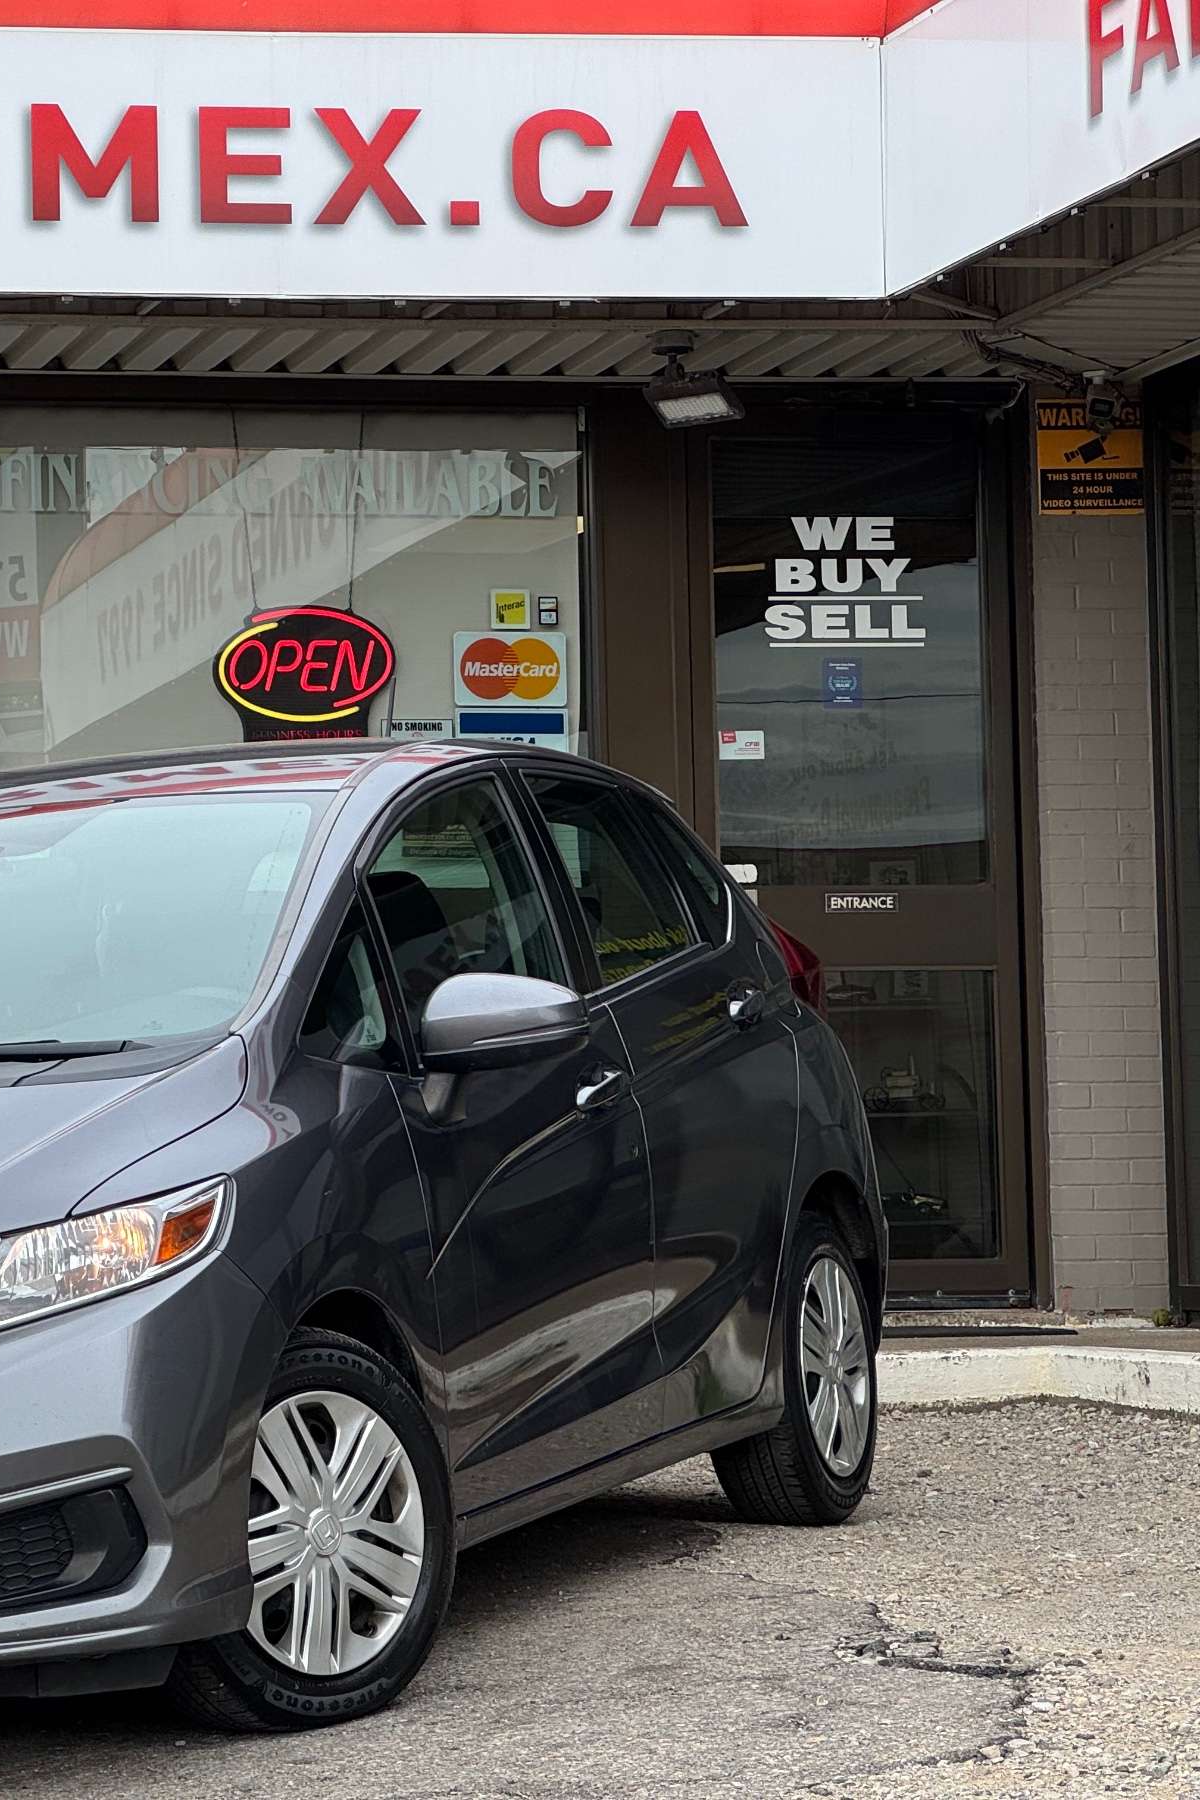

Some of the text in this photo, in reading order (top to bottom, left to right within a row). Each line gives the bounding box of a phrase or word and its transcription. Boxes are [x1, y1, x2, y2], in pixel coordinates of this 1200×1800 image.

[1088, 0, 1200, 118] FA
[1040, 407, 1140, 426] WARG!
[0, 452, 560, 518] FINANCING AVAILABLE
[1047, 473, 1069, 481] THIS
[1071, 473, 1092, 481] SITE
[1106, 472, 1138, 480] UNDER
[1072, 485, 1113, 494] 24 HOUR
[1043, 499, 1144, 508] VIDEO SURVEILLANCE
[790, 516, 895, 551] WE
[775, 558, 912, 593] BUY
[764, 604, 927, 640] SELL
[229, 639, 375, 692] OPEN
[464, 661, 558, 677] MasterCard
[391, 722, 443, 732] NO SMOKING
[830, 896, 894, 909] ENTRANCE
